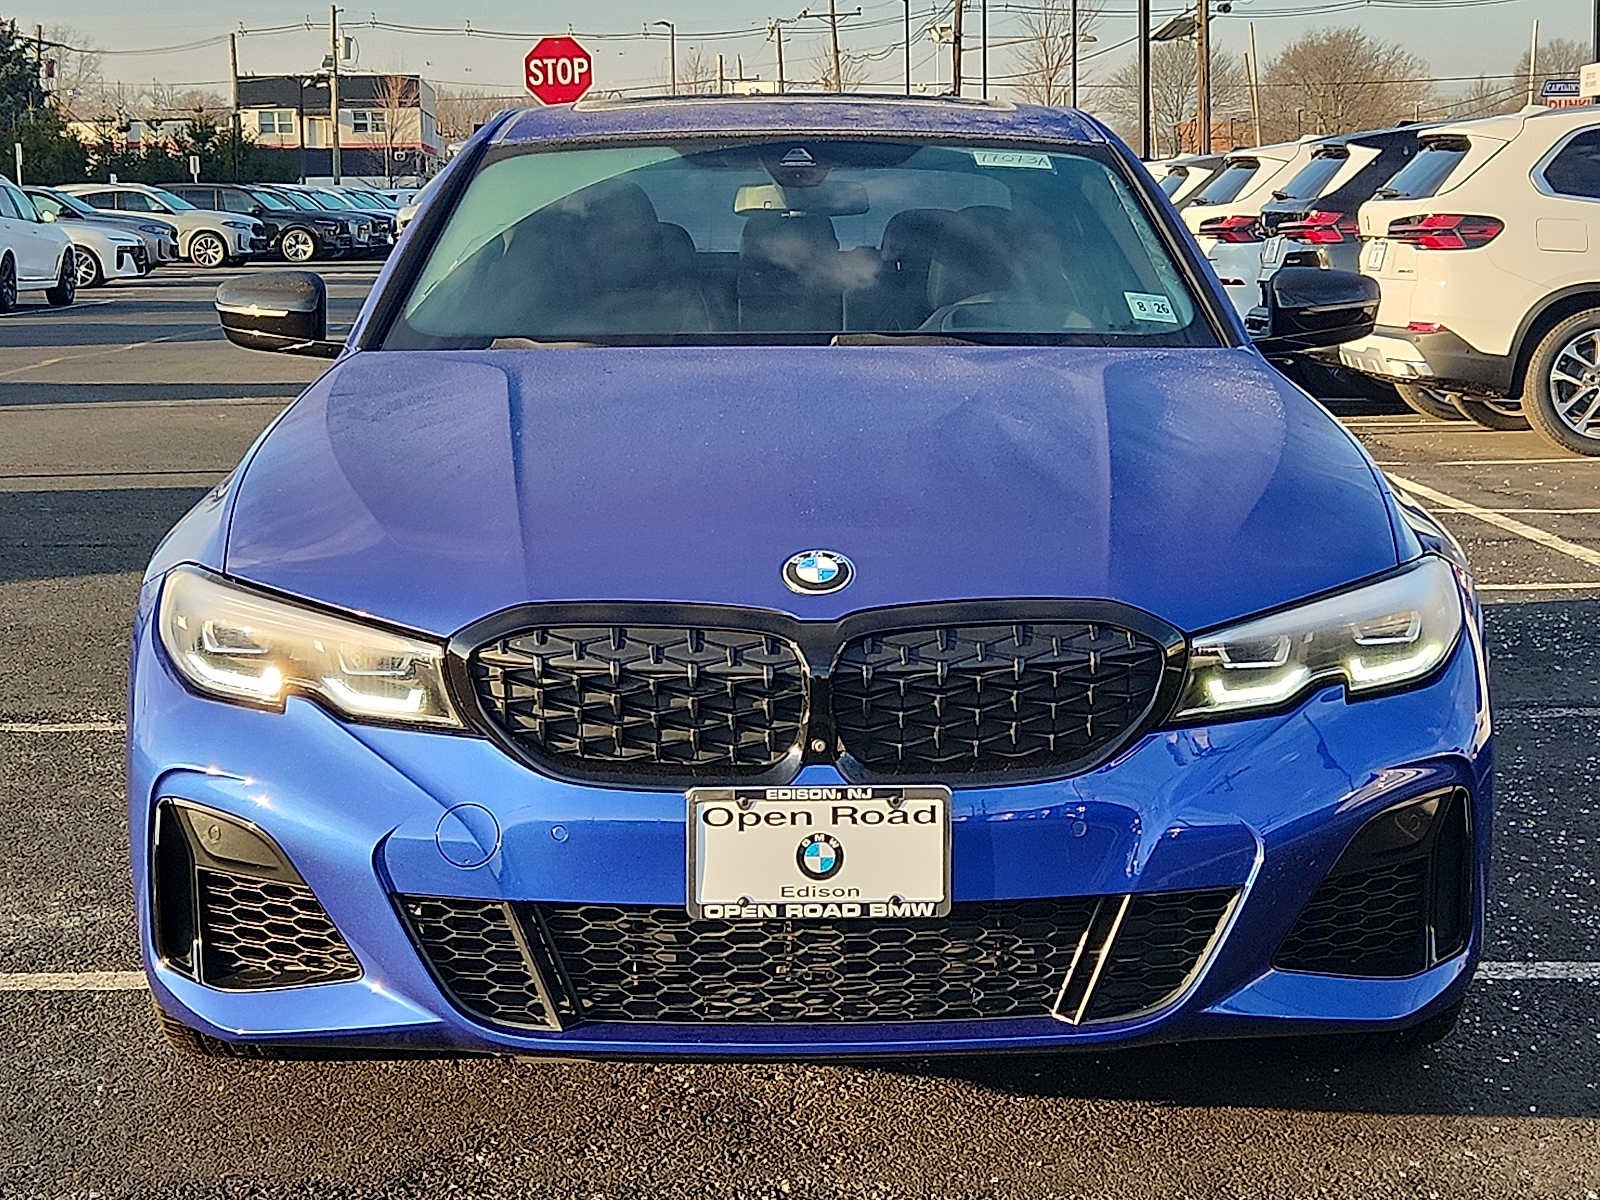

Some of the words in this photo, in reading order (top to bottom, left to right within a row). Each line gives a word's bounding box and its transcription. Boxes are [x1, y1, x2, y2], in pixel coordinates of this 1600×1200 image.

[528, 57, 589, 86] STOP
[1136, 301, 1147, 312] 8
[1153, 302, 1170, 314] 26
[847, 788, 872, 799] NJ
[702, 807, 813, 832] Open
[831, 805, 937, 826] Road
[801, 834, 840, 848] BMW
[781, 886, 860, 898] Edison
[703, 904, 778, 919] OPEN
[785, 904, 861, 918] ROAD
[869, 903, 936, 918] BMW
